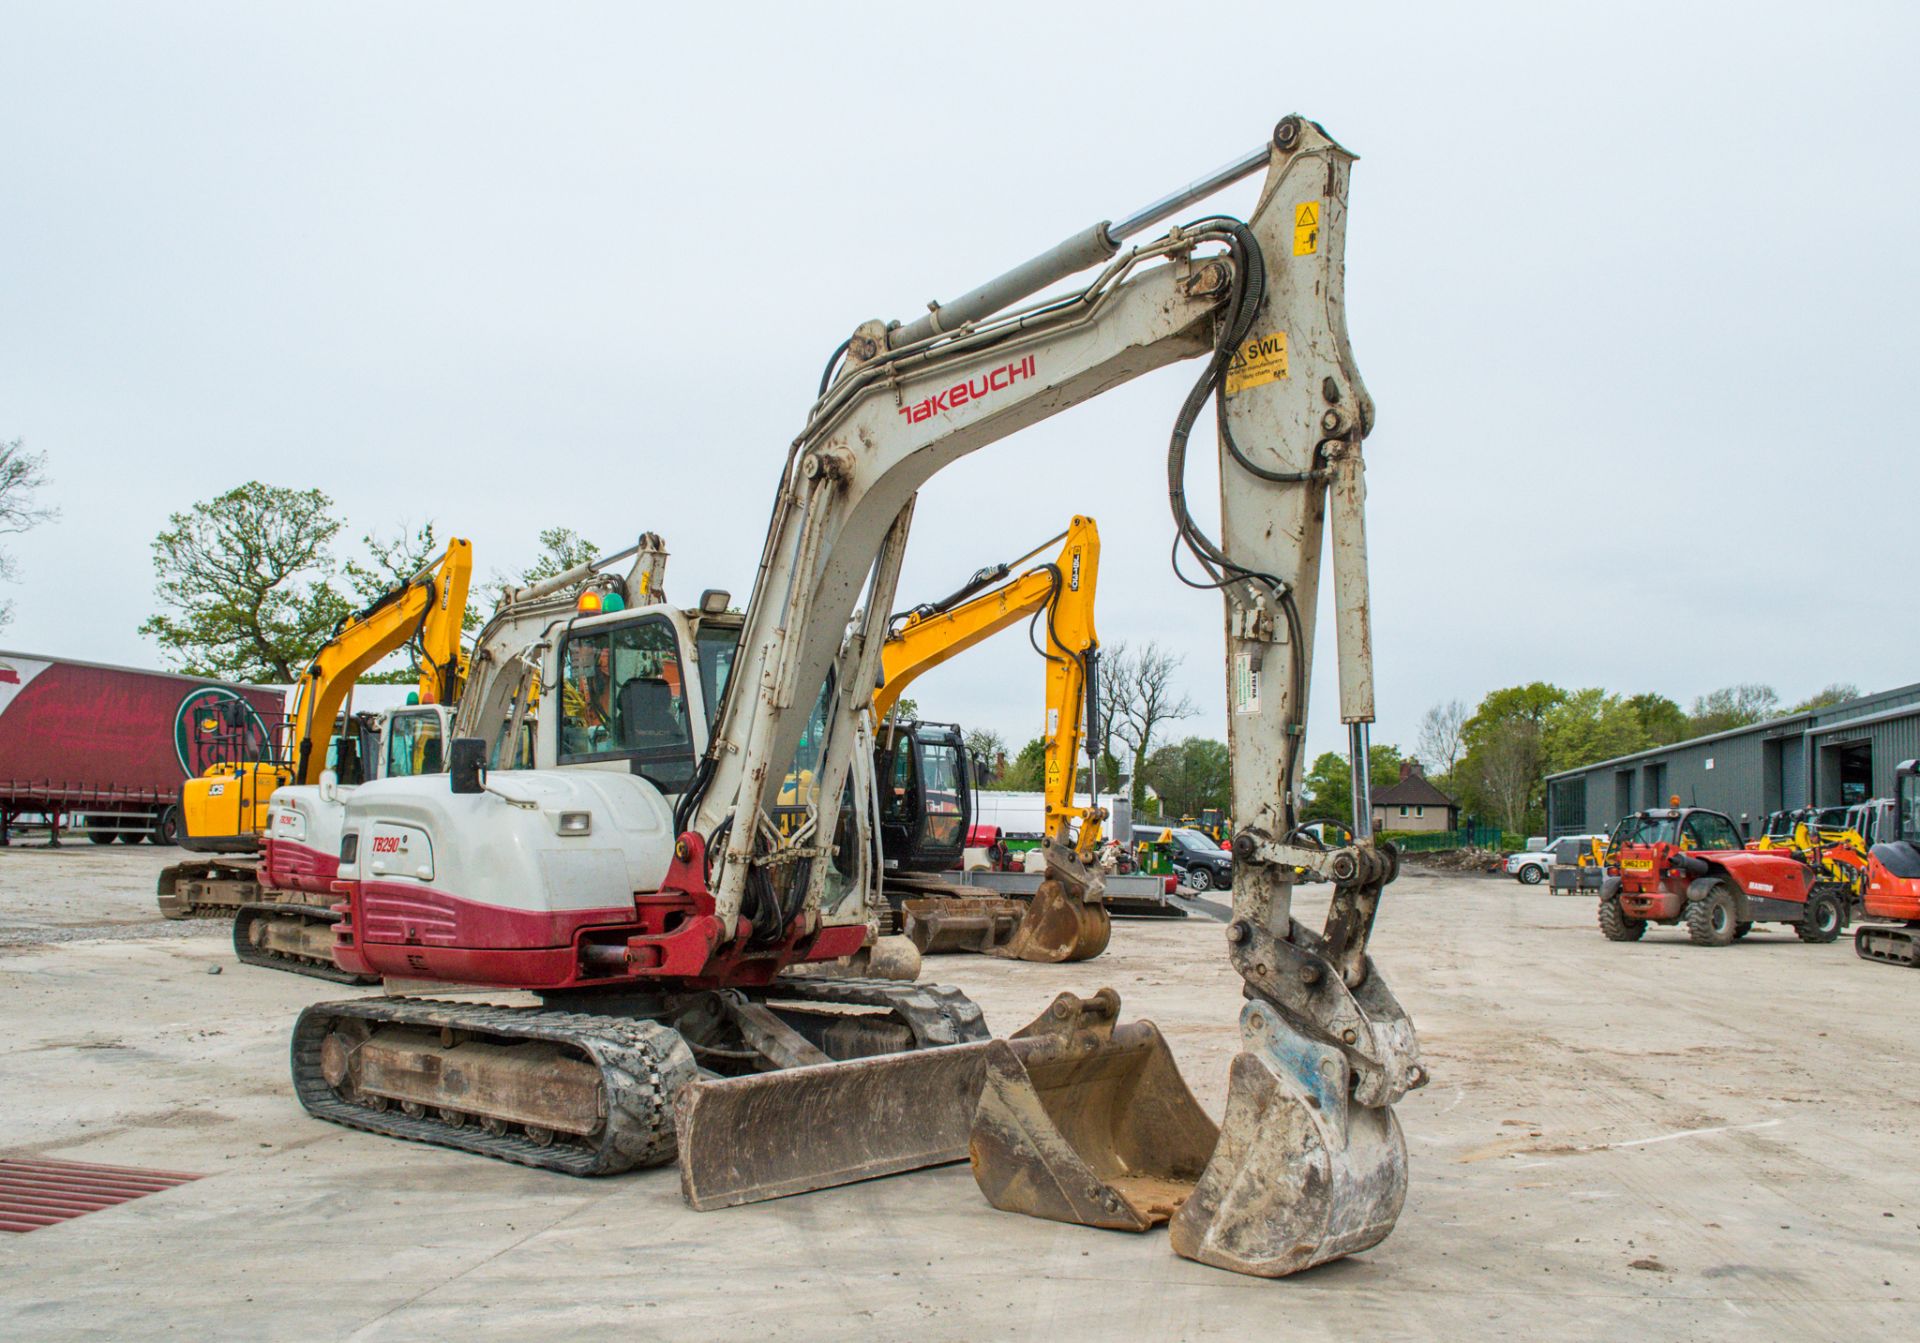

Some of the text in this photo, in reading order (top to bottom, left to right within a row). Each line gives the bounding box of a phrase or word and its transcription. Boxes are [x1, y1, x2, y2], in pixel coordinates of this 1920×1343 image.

[1248, 338, 1284, 359] SWL
[898, 354, 1036, 425] TAKEUCHI
[208, 784, 224, 796] JCB
[372, 836, 400, 853] TB290
